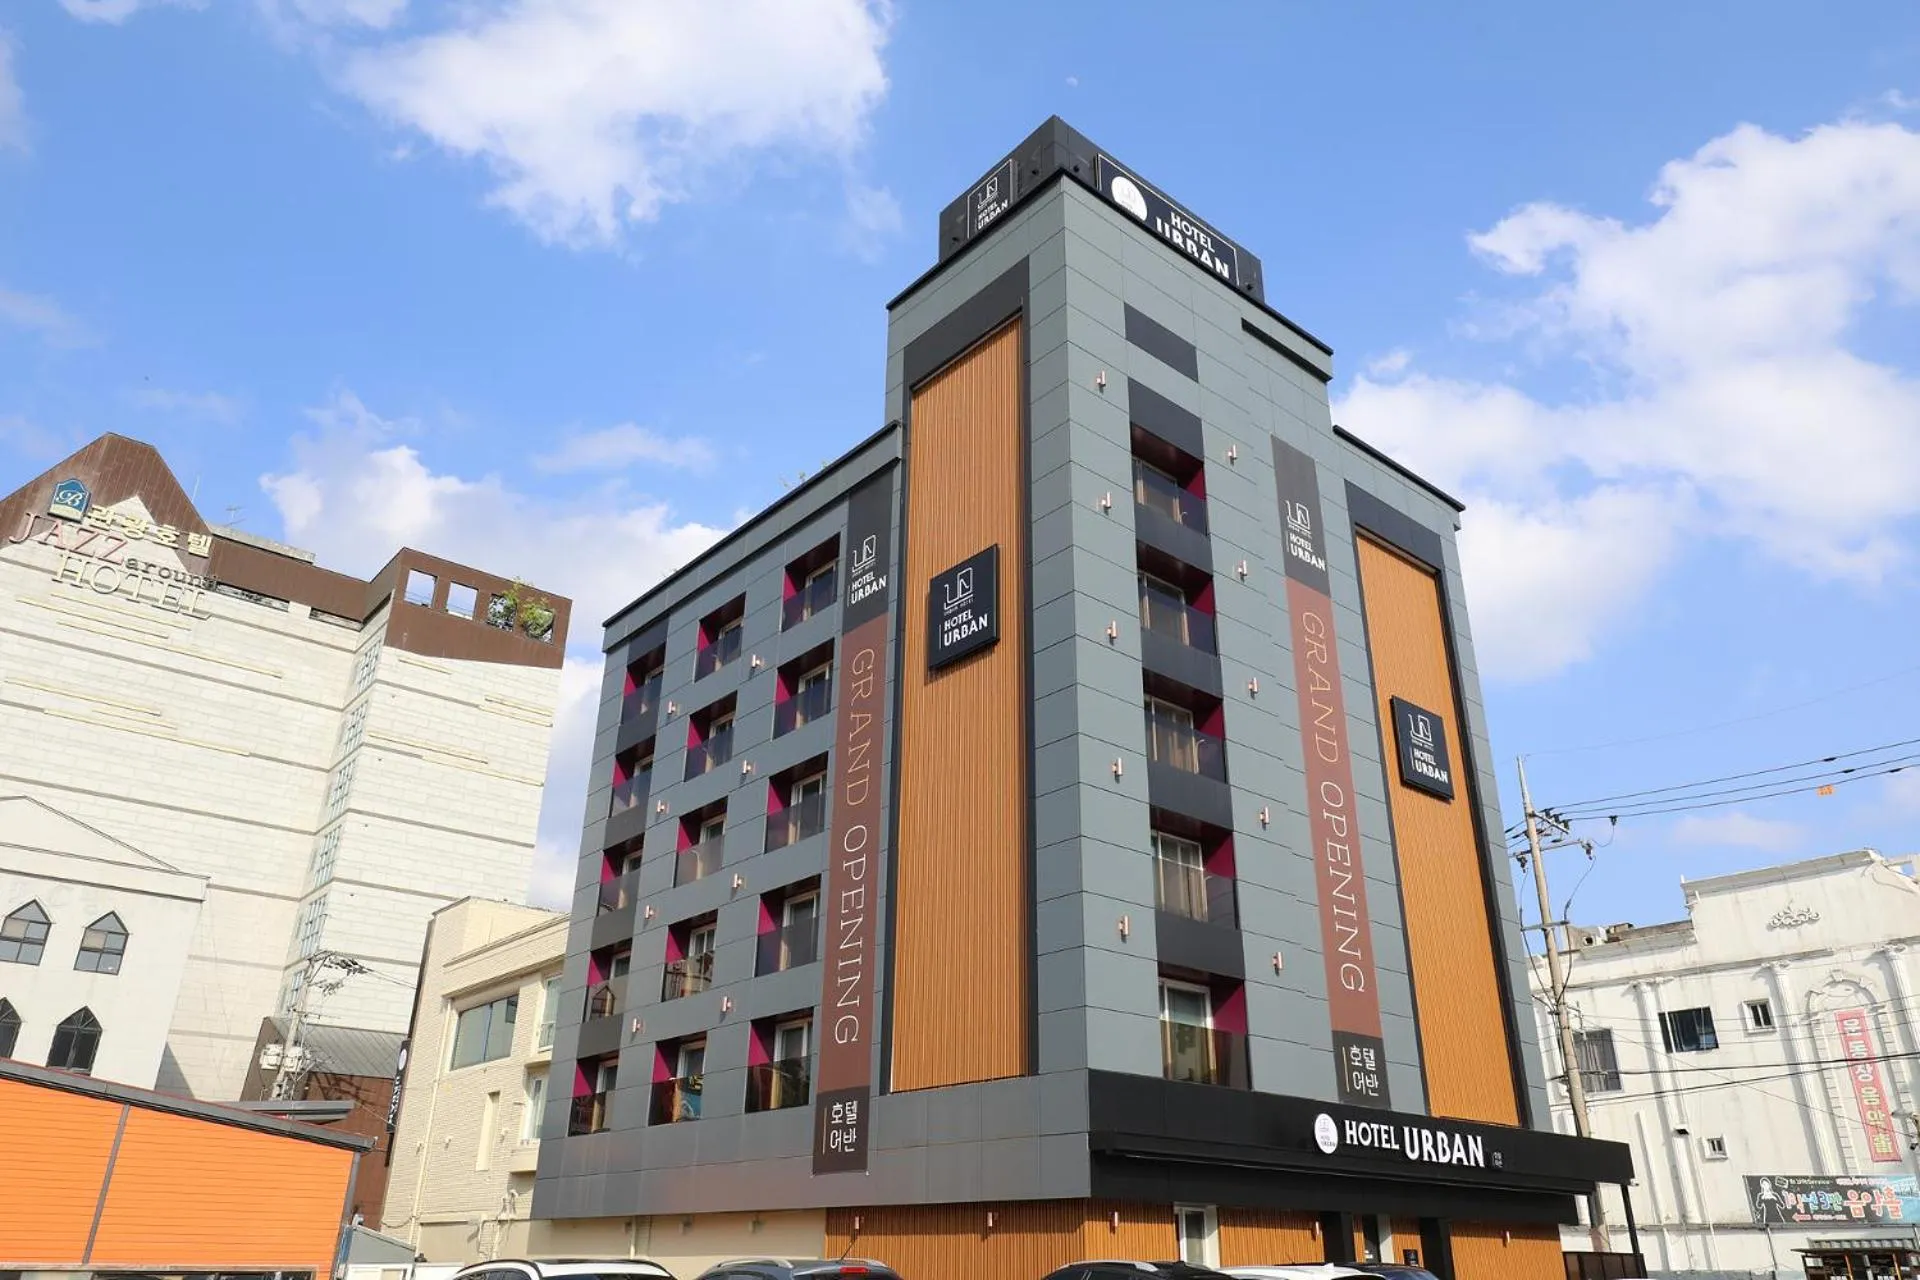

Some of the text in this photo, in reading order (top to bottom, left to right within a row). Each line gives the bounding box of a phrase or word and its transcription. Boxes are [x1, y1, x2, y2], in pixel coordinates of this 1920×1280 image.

[1170, 211, 1215, 253] HOTEL
[9, 512, 128, 566] JAZZ
[1290, 532, 1313, 552] HOTEL
[1290, 543, 1325, 571] URBAN
[52, 551, 213, 621] HOTEL
[851, 571, 875, 591] HOTEL
[851, 575, 887, 604] URBAN
[944, 609, 973, 631] HOTEL
[944, 613, 988, 646] URBAN
[1413, 747, 1436, 766] HOTEL
[1415, 760, 1448, 784] URBAN
[1302, 611, 1365, 992] GRAND OPENING
[835, 648, 875, 1044] GRAND OPENING
[1350, 1044, 1376, 1070] 호텔
[1353, 1071, 1379, 1097] 어반
[831, 1100, 858, 1125] 호텔
[830, 1127, 857, 1152] 어반
[1344, 1119, 1400, 1150] HOTEL
[1403, 1126, 1485, 1168] URBAN
[1843, 1186, 1903, 1220] 음악홀
